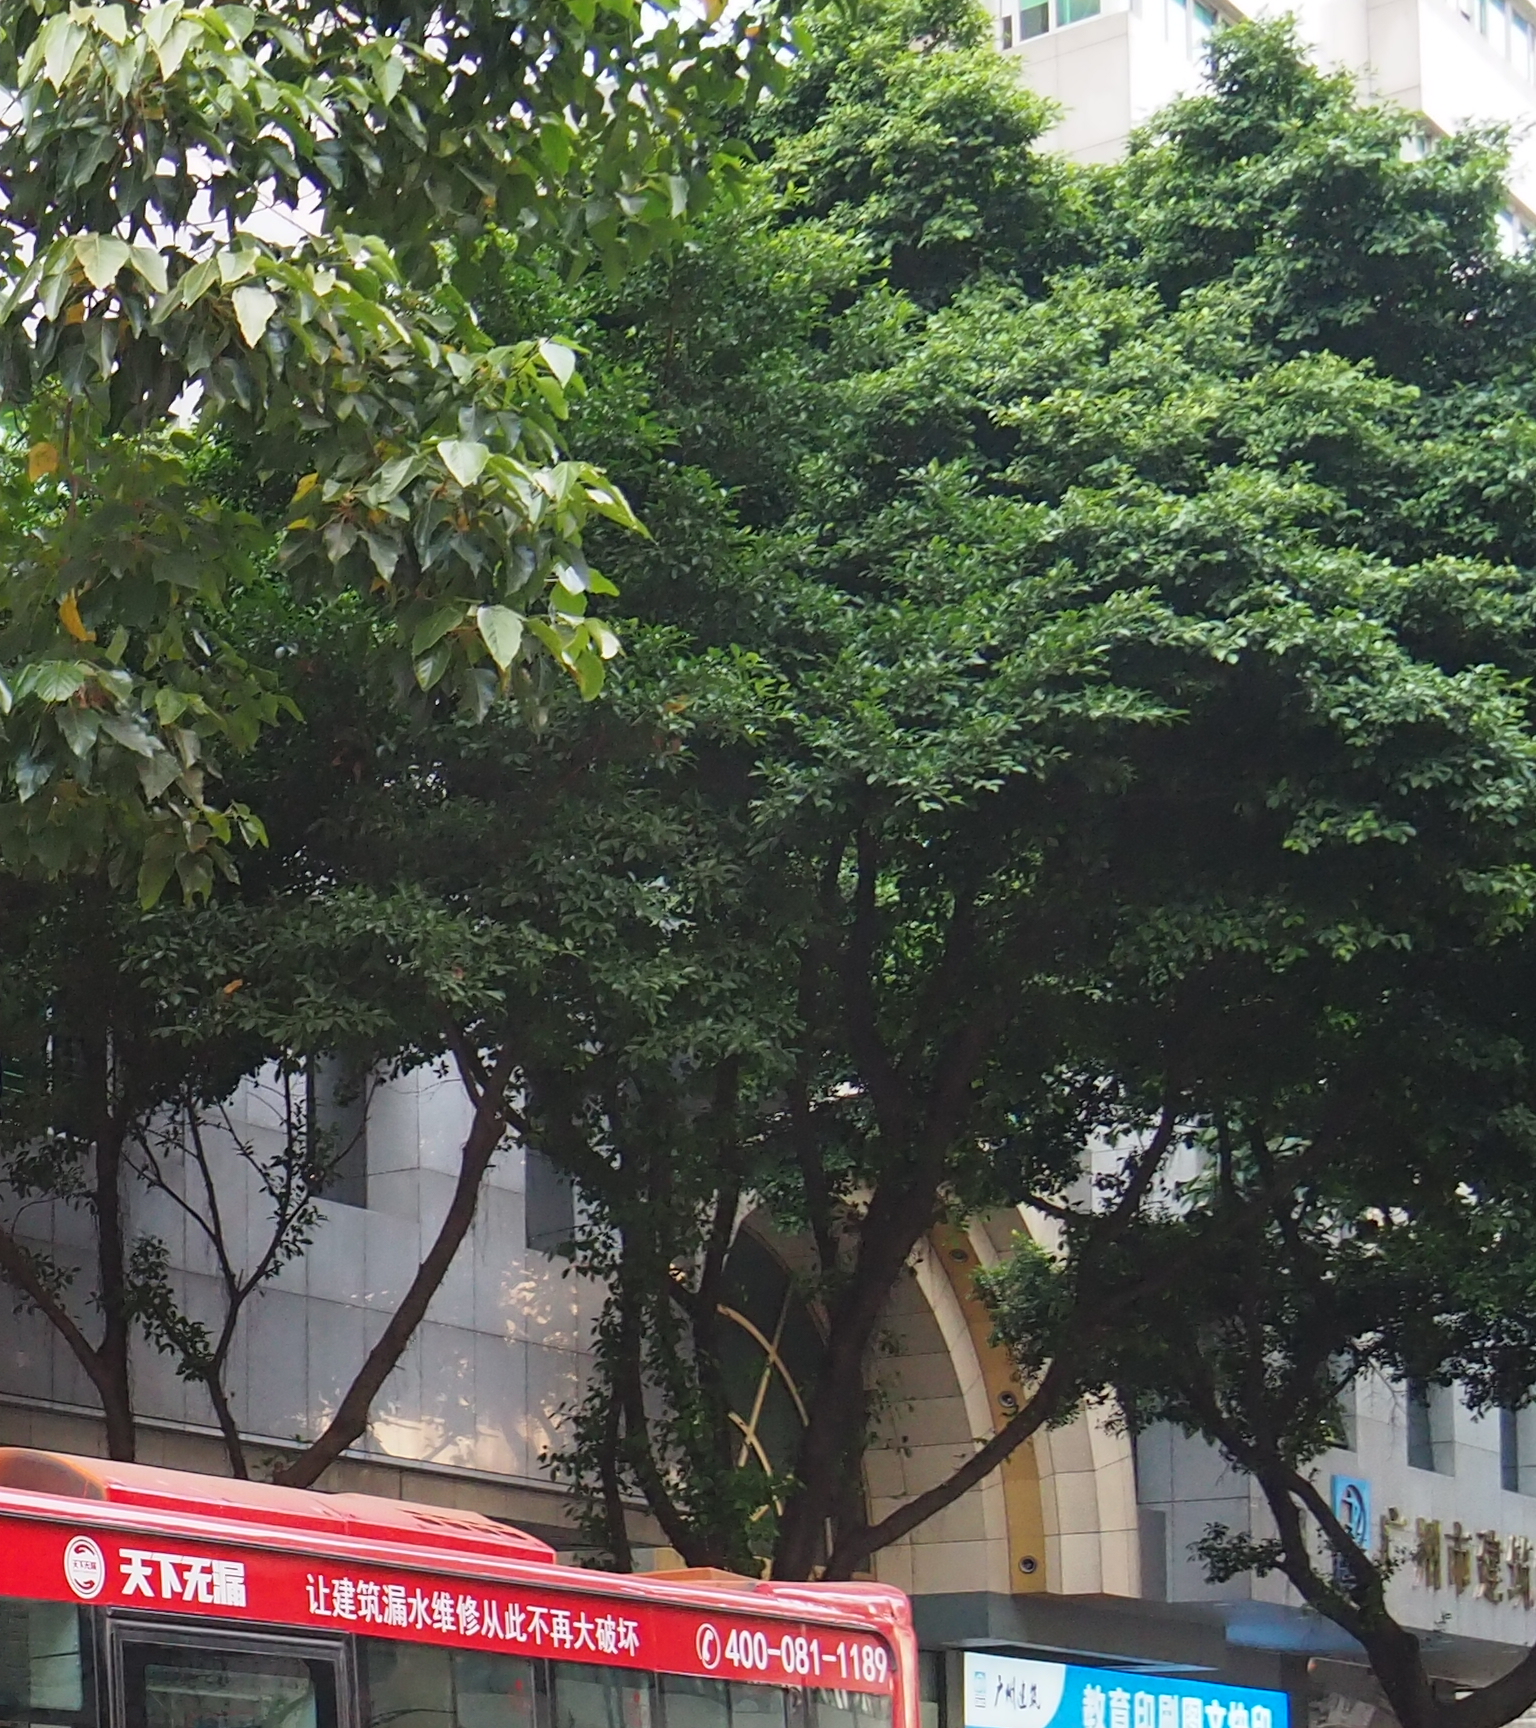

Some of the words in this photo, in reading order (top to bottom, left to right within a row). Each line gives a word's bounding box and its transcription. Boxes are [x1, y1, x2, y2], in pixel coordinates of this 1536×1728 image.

[118, 1548, 247, 1608] 天下无漏
[305, 1573, 640, 1657] 让建筑漏水维修从此不再大破坏
[724, 1629, 888, 1683] 400-081-1189
